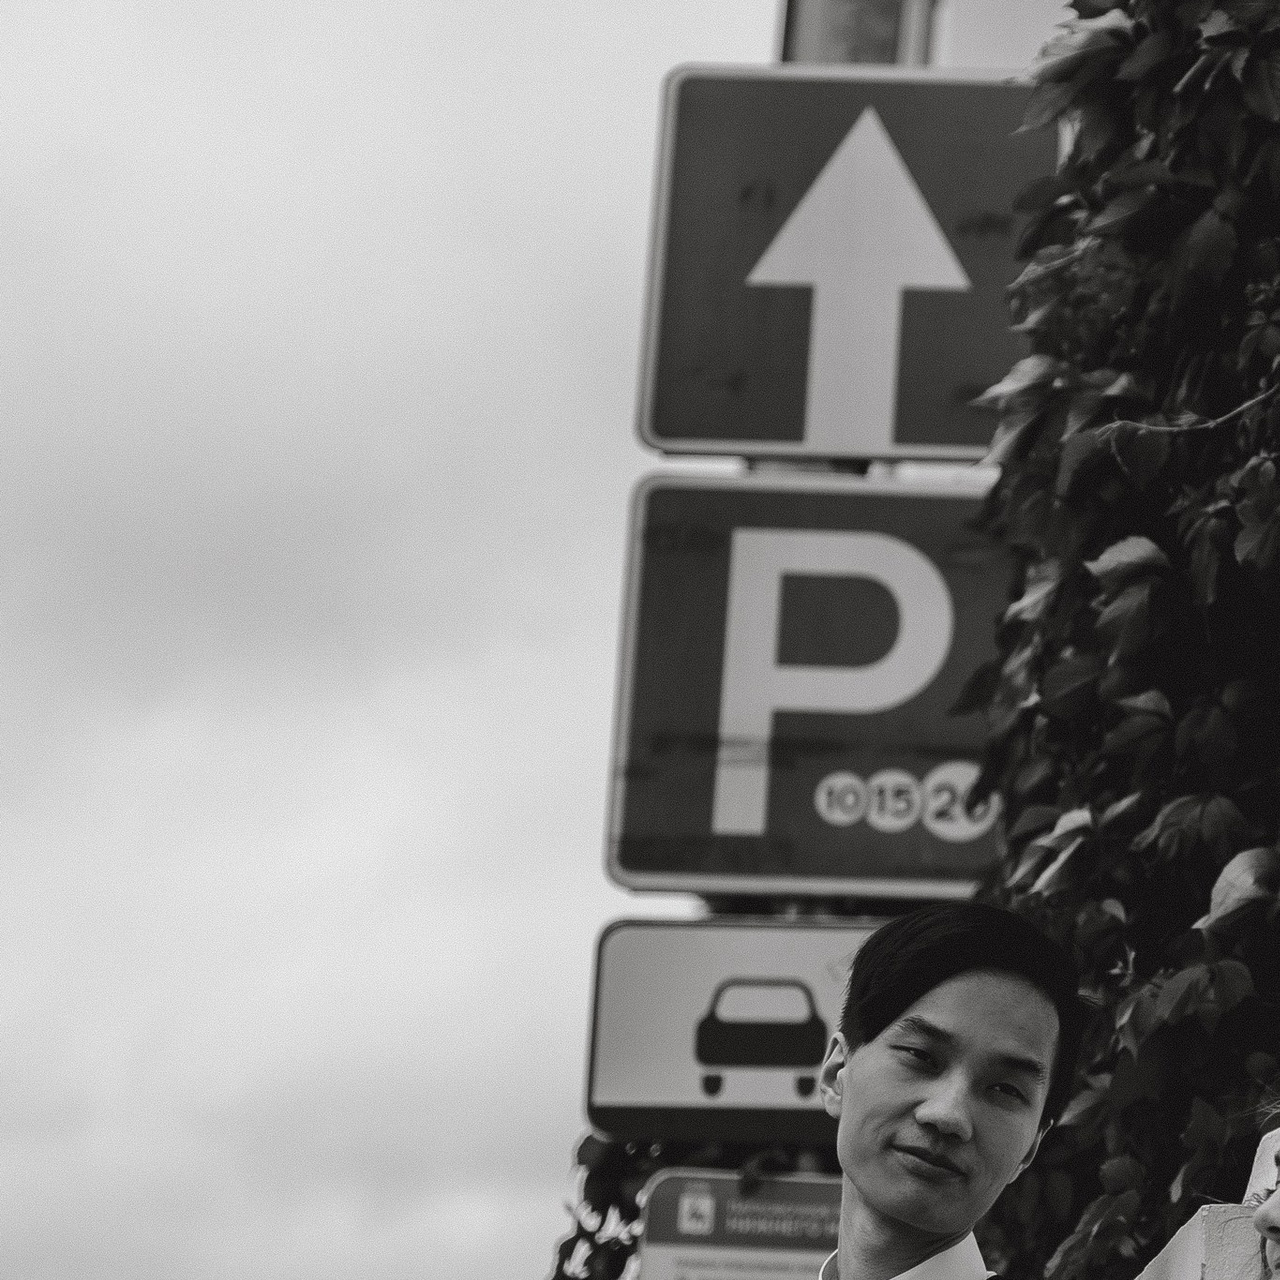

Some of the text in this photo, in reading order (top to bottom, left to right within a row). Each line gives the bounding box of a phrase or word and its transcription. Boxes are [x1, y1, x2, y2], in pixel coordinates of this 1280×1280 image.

[711, 526, 955, 836] P
[826, 784, 861, 815] 10
[876, 784, 913, 817] 15
